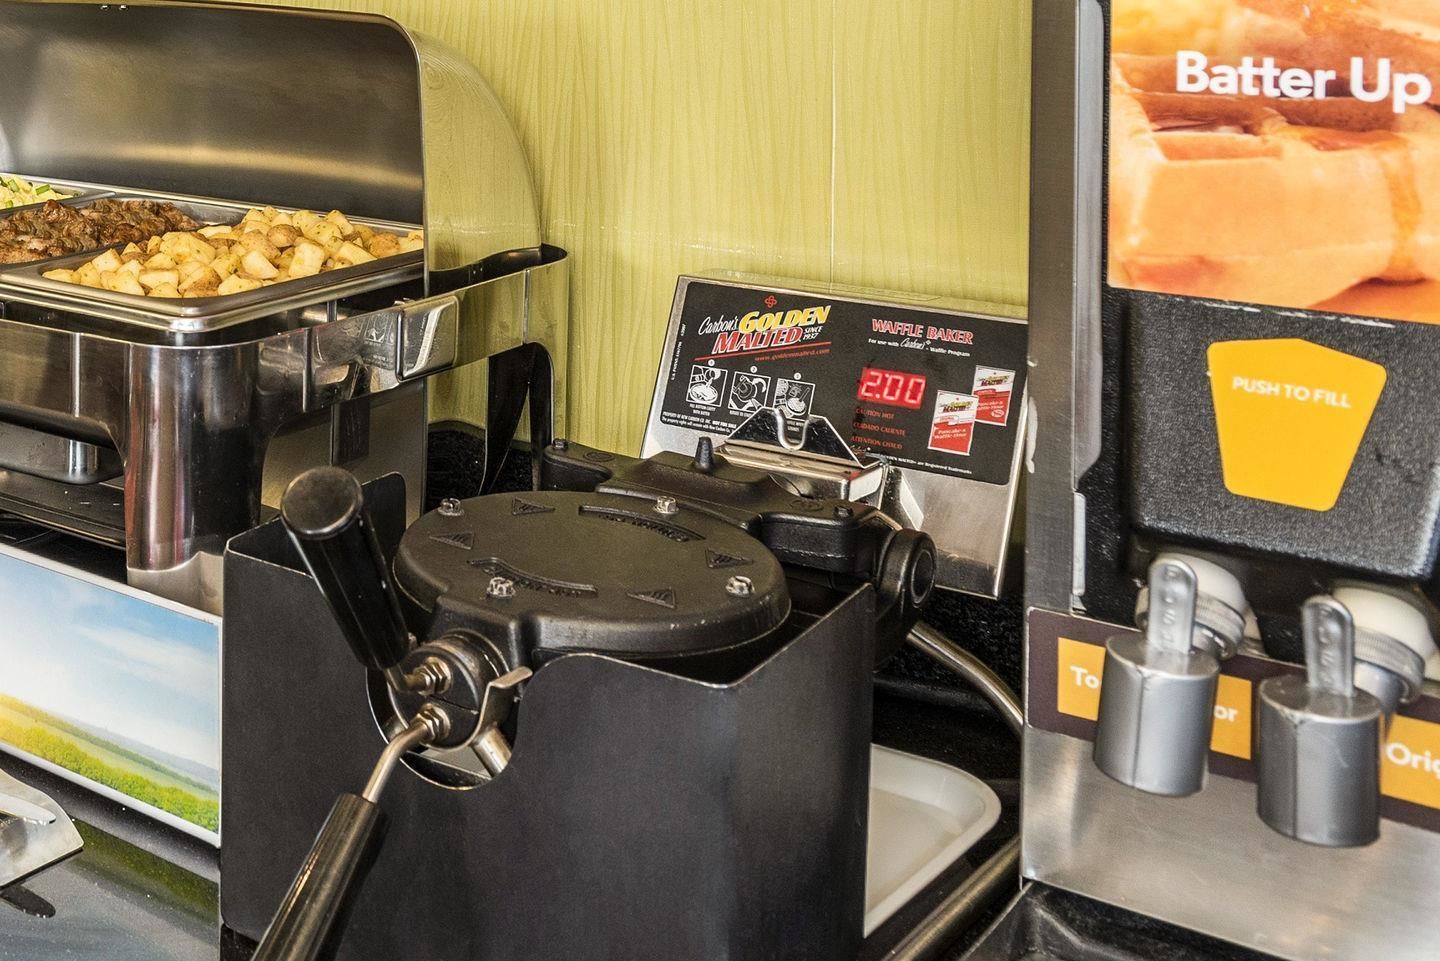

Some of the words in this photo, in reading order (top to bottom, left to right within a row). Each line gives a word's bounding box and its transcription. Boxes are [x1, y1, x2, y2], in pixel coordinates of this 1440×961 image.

[1176, 50, 1336, 99] Batter
[1349, 56, 1432, 113] Up
[738, 305, 832, 334] GOLDEN
[805, 326, 824, 334] SINCE
[872, 319, 924, 338] WAFFLE
[926, 326, 974, 345] BAKER
[712, 327, 804, 354] MALTED
[1232, 376, 1280, 396] PUSH
[1284, 383, 1310, 401] TO
[1313, 388, 1351, 408] FILL
